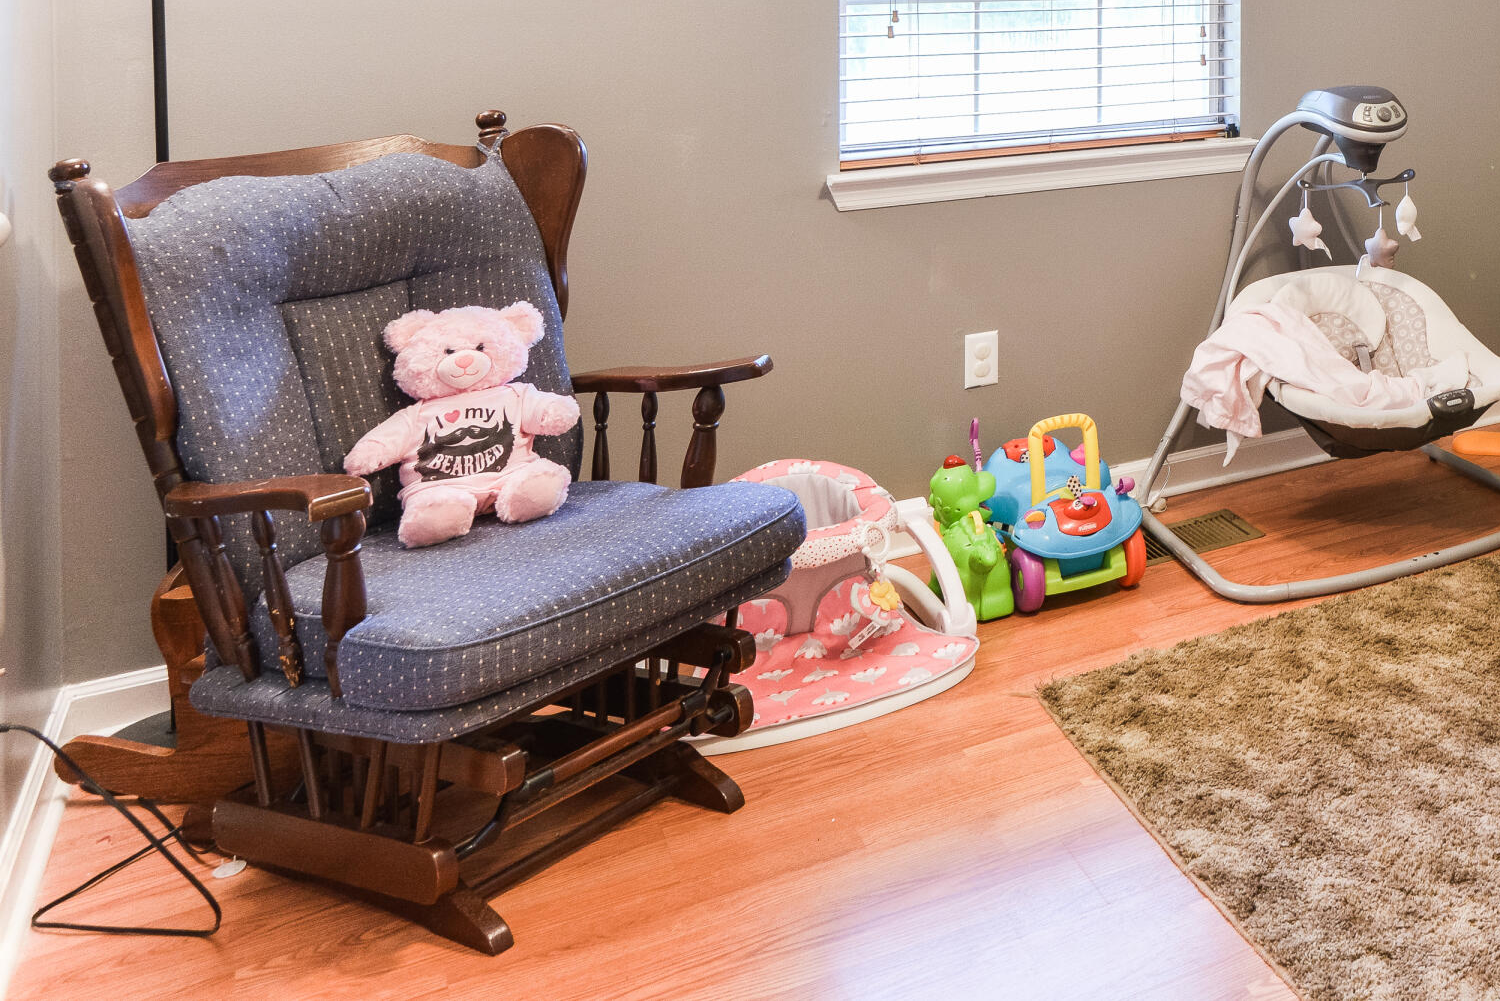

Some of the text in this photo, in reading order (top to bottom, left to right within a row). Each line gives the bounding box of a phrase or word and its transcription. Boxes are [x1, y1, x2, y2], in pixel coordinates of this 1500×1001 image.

[435, 407, 496, 430] I my
[426, 444, 504, 477] BEARDED
